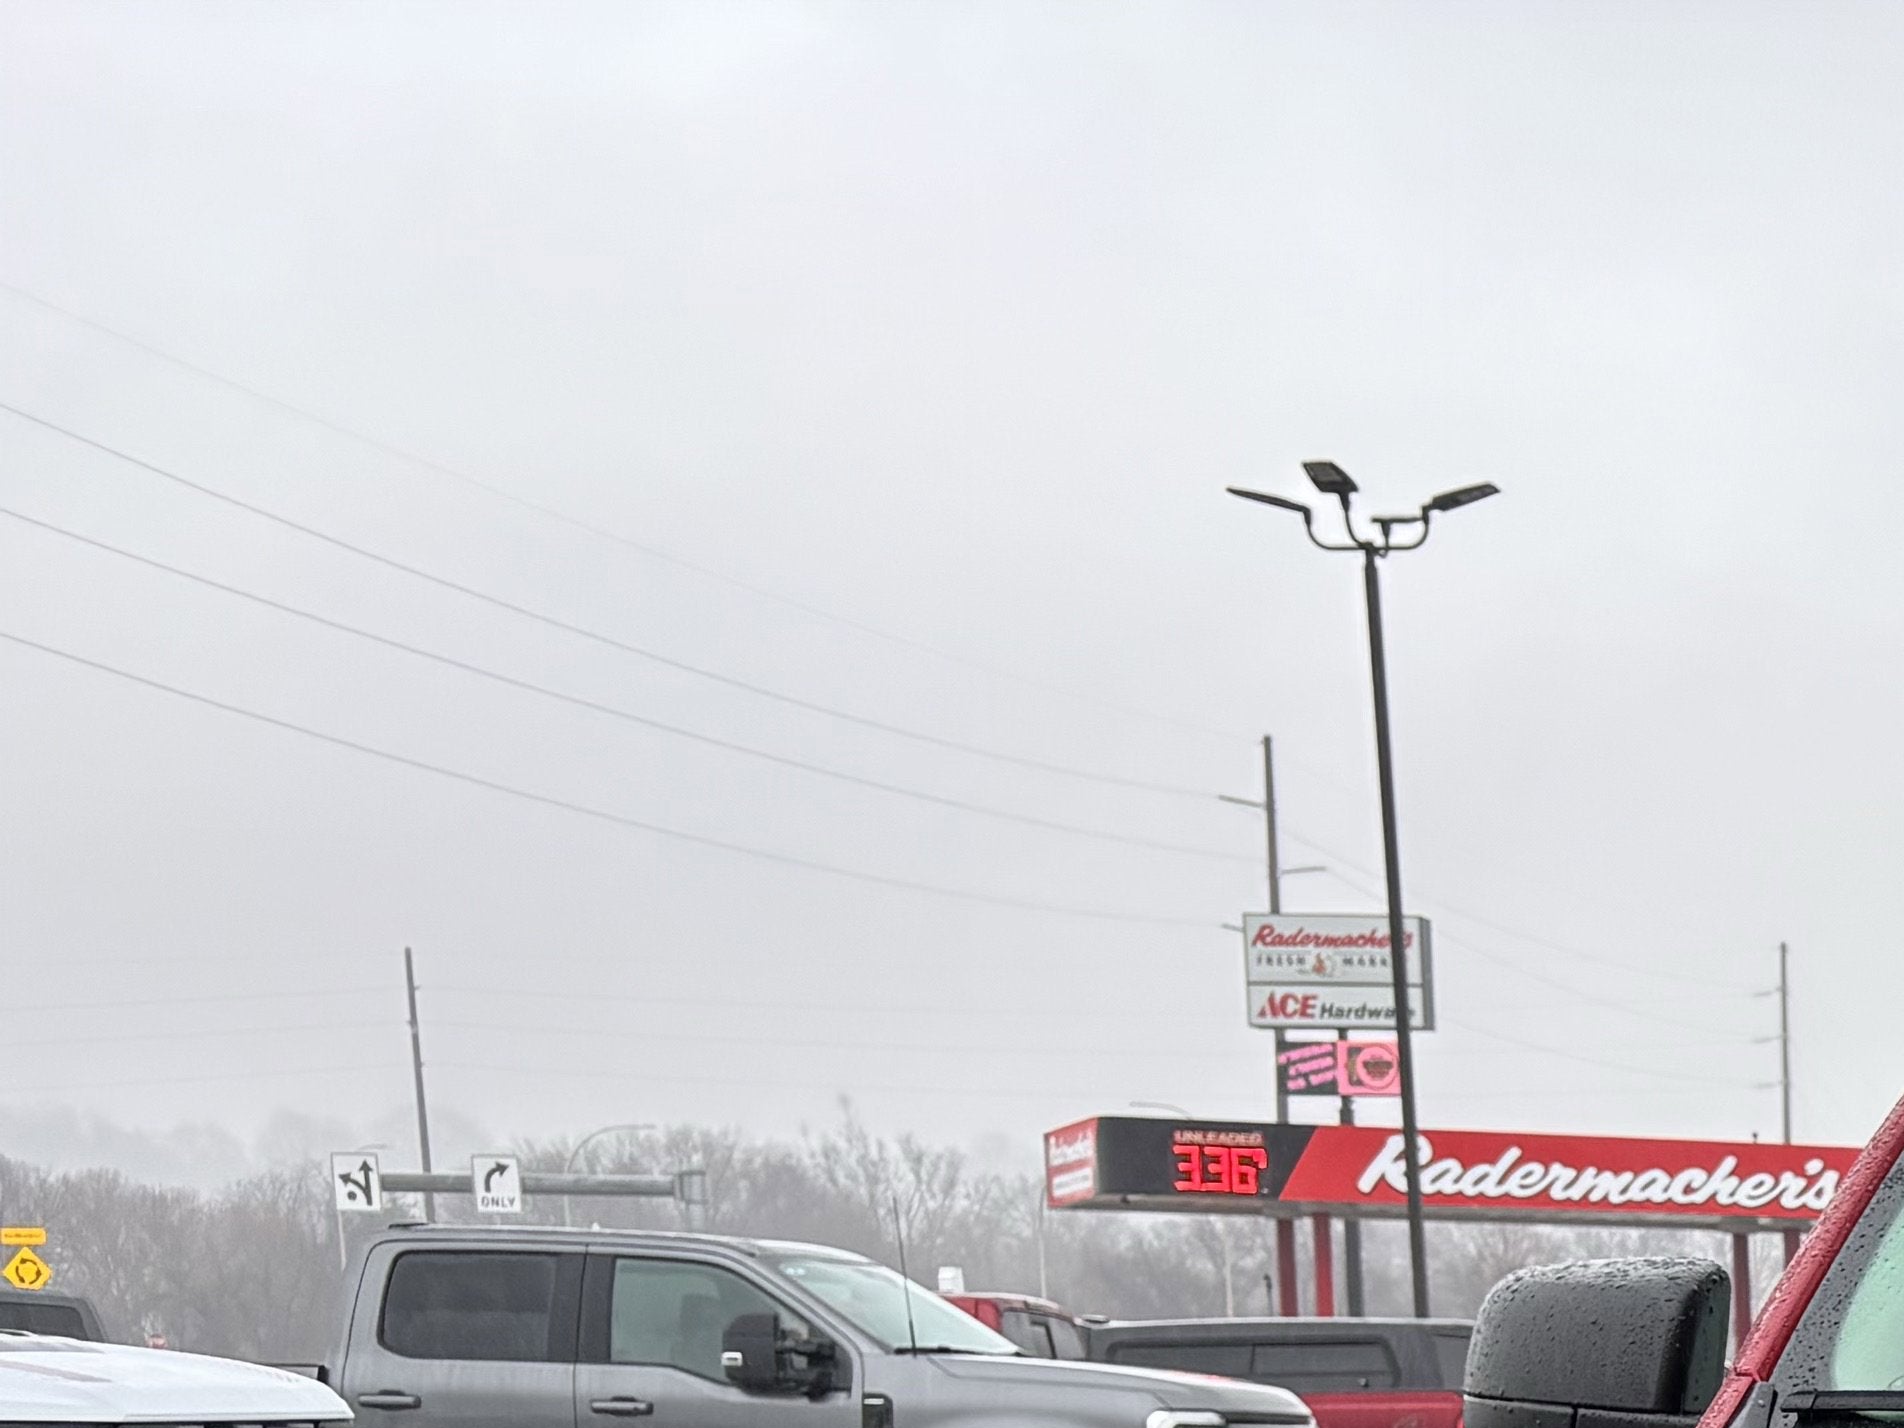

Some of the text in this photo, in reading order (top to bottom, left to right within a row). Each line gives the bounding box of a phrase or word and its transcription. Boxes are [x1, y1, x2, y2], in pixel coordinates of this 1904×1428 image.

[1257, 991, 1319, 1019] ACE
[1174, 1130, 1264, 1145] UNLEADED
[1357, 1134, 1841, 1211] Radermacher's
[481, 1196, 516, 1208] ONLY
